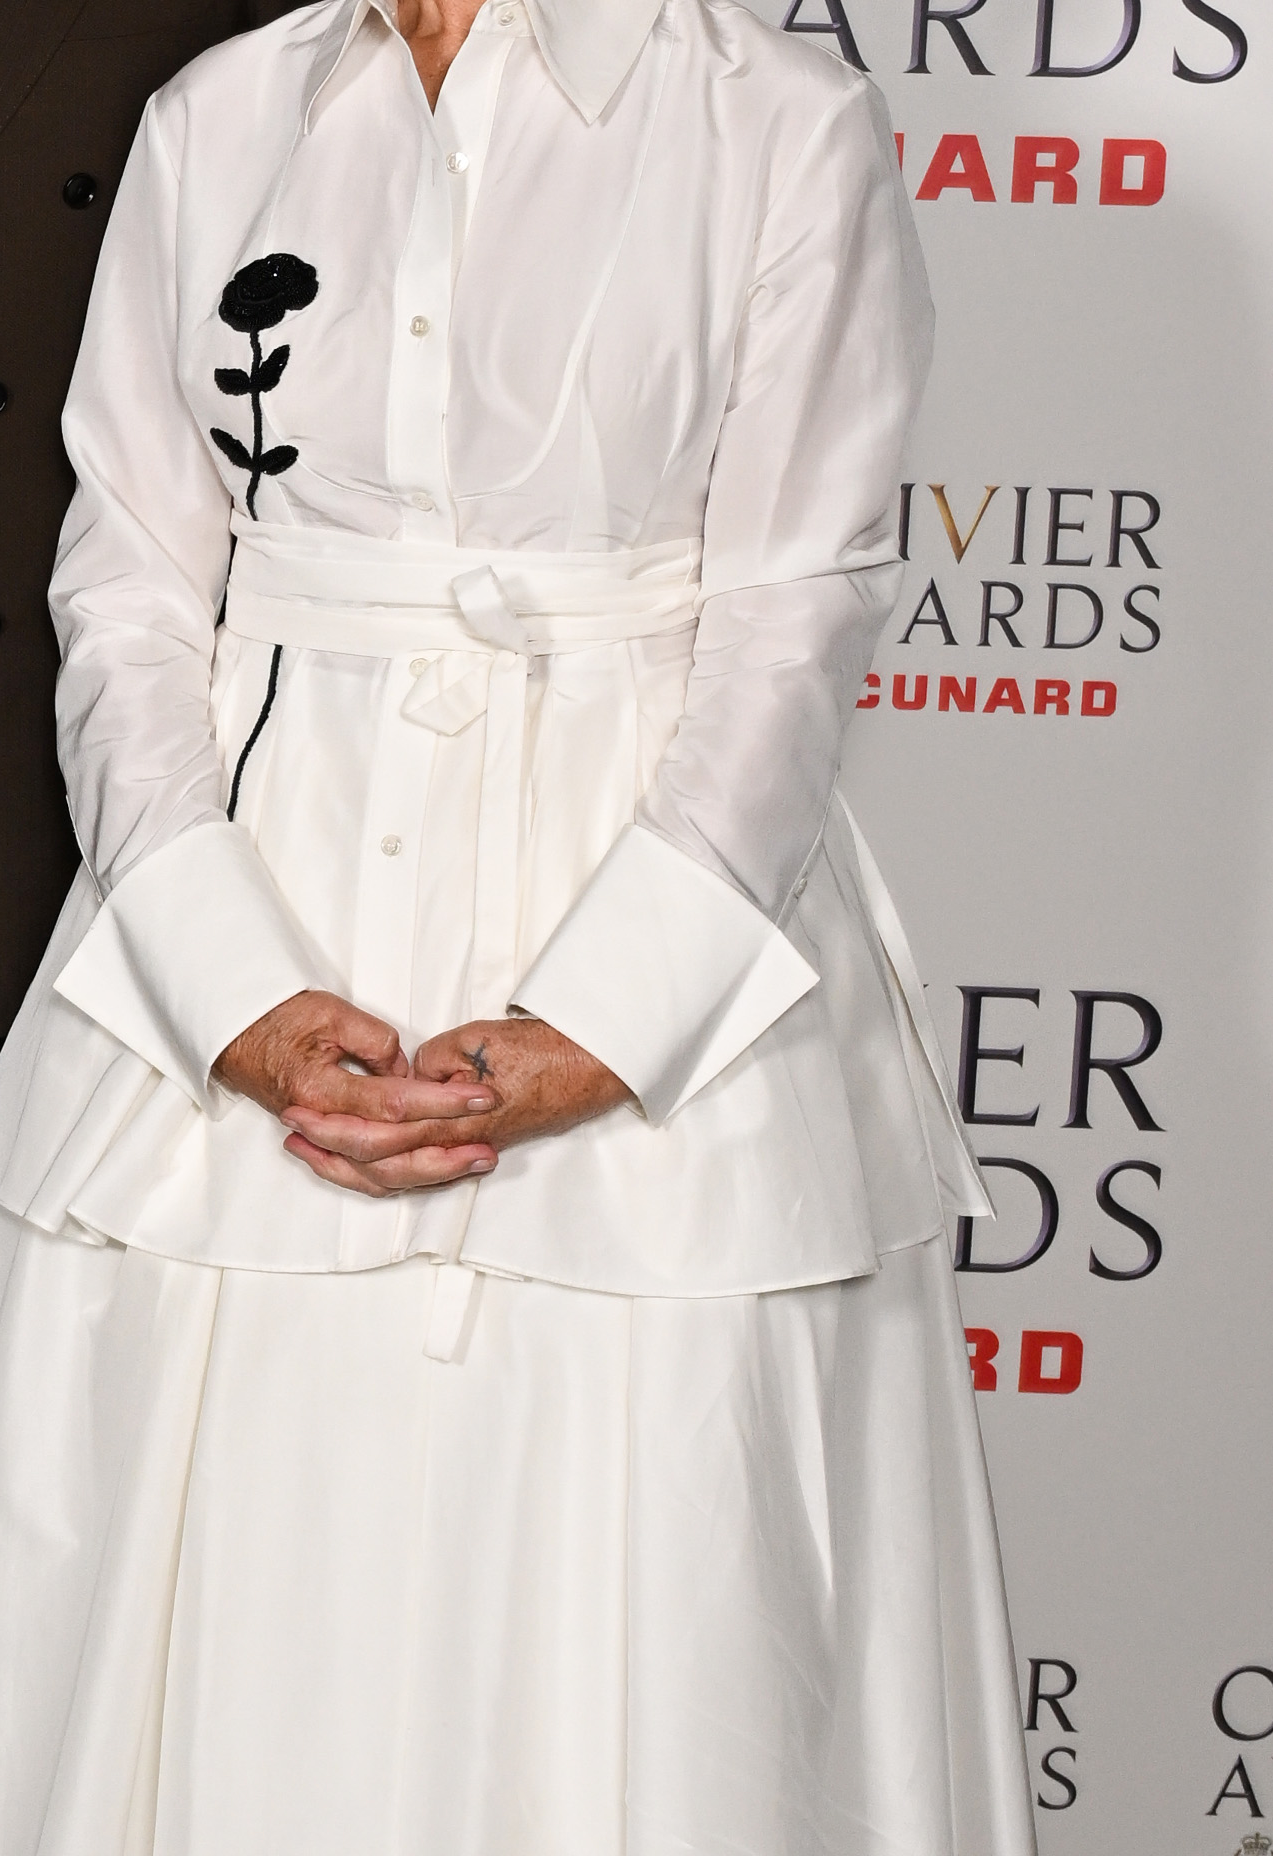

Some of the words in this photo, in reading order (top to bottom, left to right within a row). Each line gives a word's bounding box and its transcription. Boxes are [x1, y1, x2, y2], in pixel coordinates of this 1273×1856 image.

[894, 131, 1168, 207] ARD
[898, 482, 1163, 570] IVIER
[896, 576, 1162, 654] ARDS
